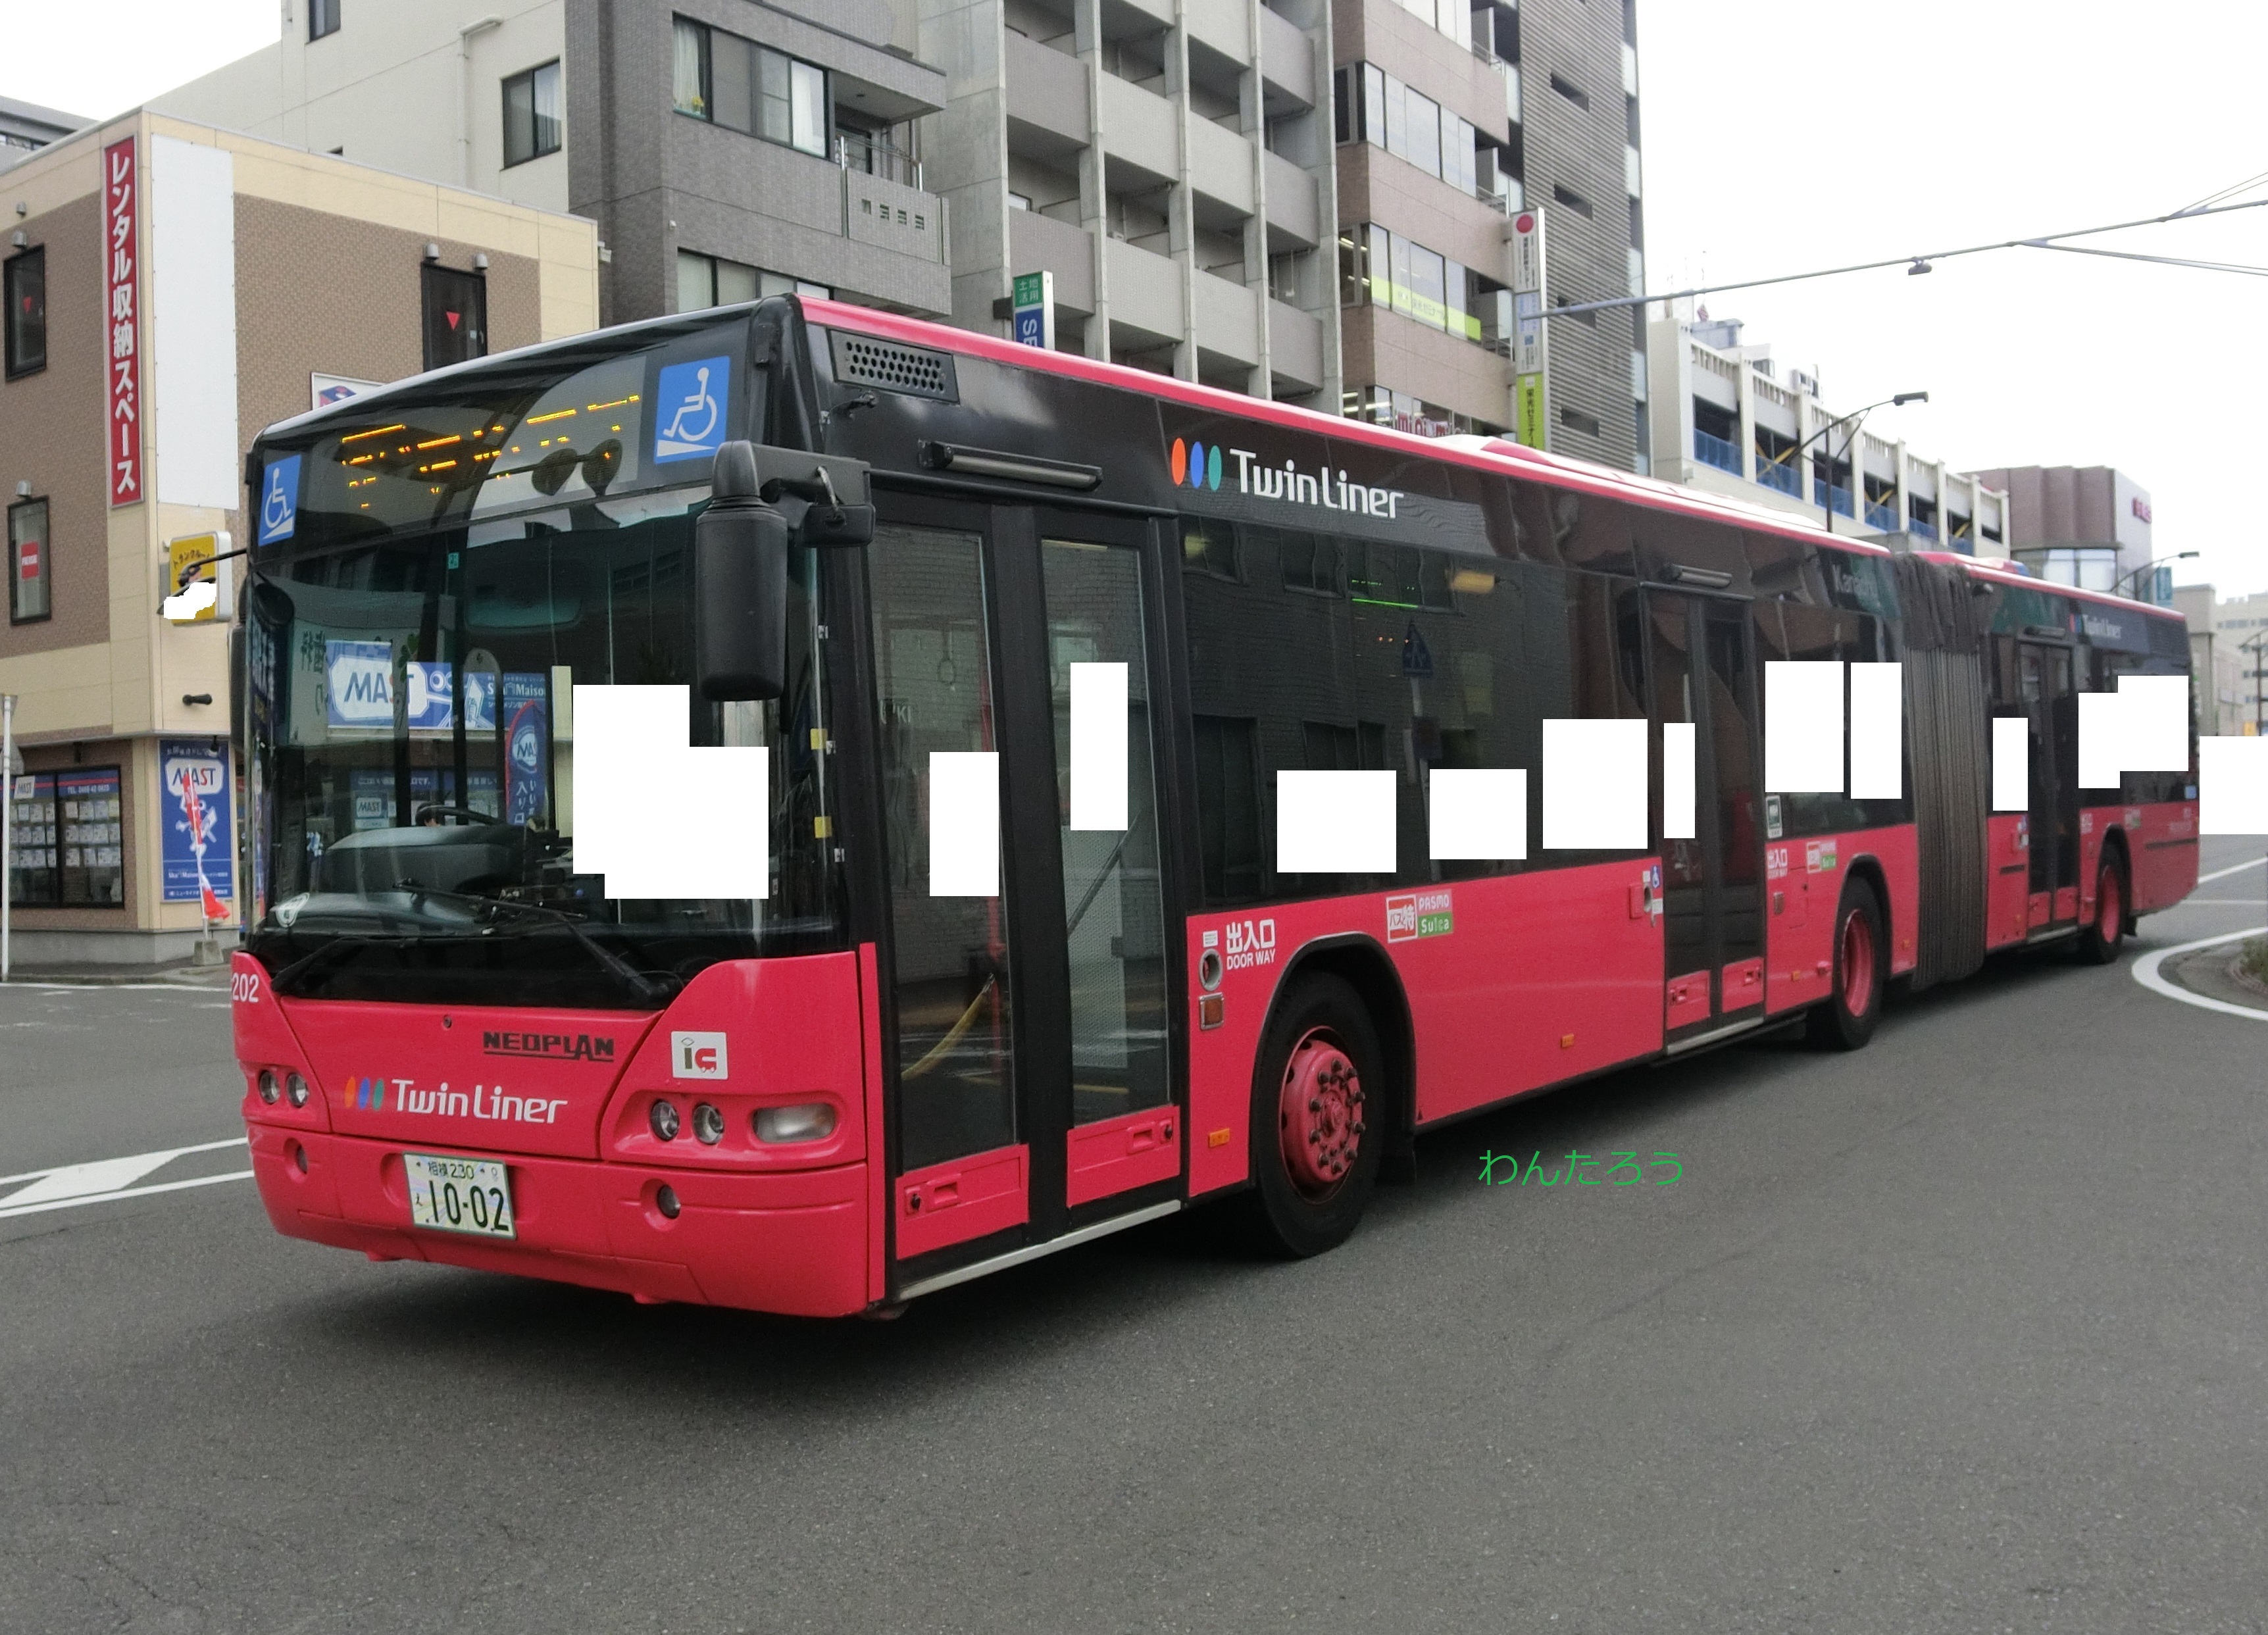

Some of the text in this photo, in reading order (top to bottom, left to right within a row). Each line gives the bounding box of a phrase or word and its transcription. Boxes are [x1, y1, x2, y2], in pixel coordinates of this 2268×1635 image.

[112, 152, 136, 495] レンタル収納スペース
[515, 683, 546, 696] Maiso
[172, 767, 216, 786] MAST
[1419, 894, 1449, 911] PASMO
[1226, 918, 1276, 954] 出入口
[1421, 917, 1449, 934] Suica
[1226, 948, 1276, 970] DOOR WAY
[231, 972, 259, 1003] 202
[483, 1031, 615, 1061] NEOPLAN
